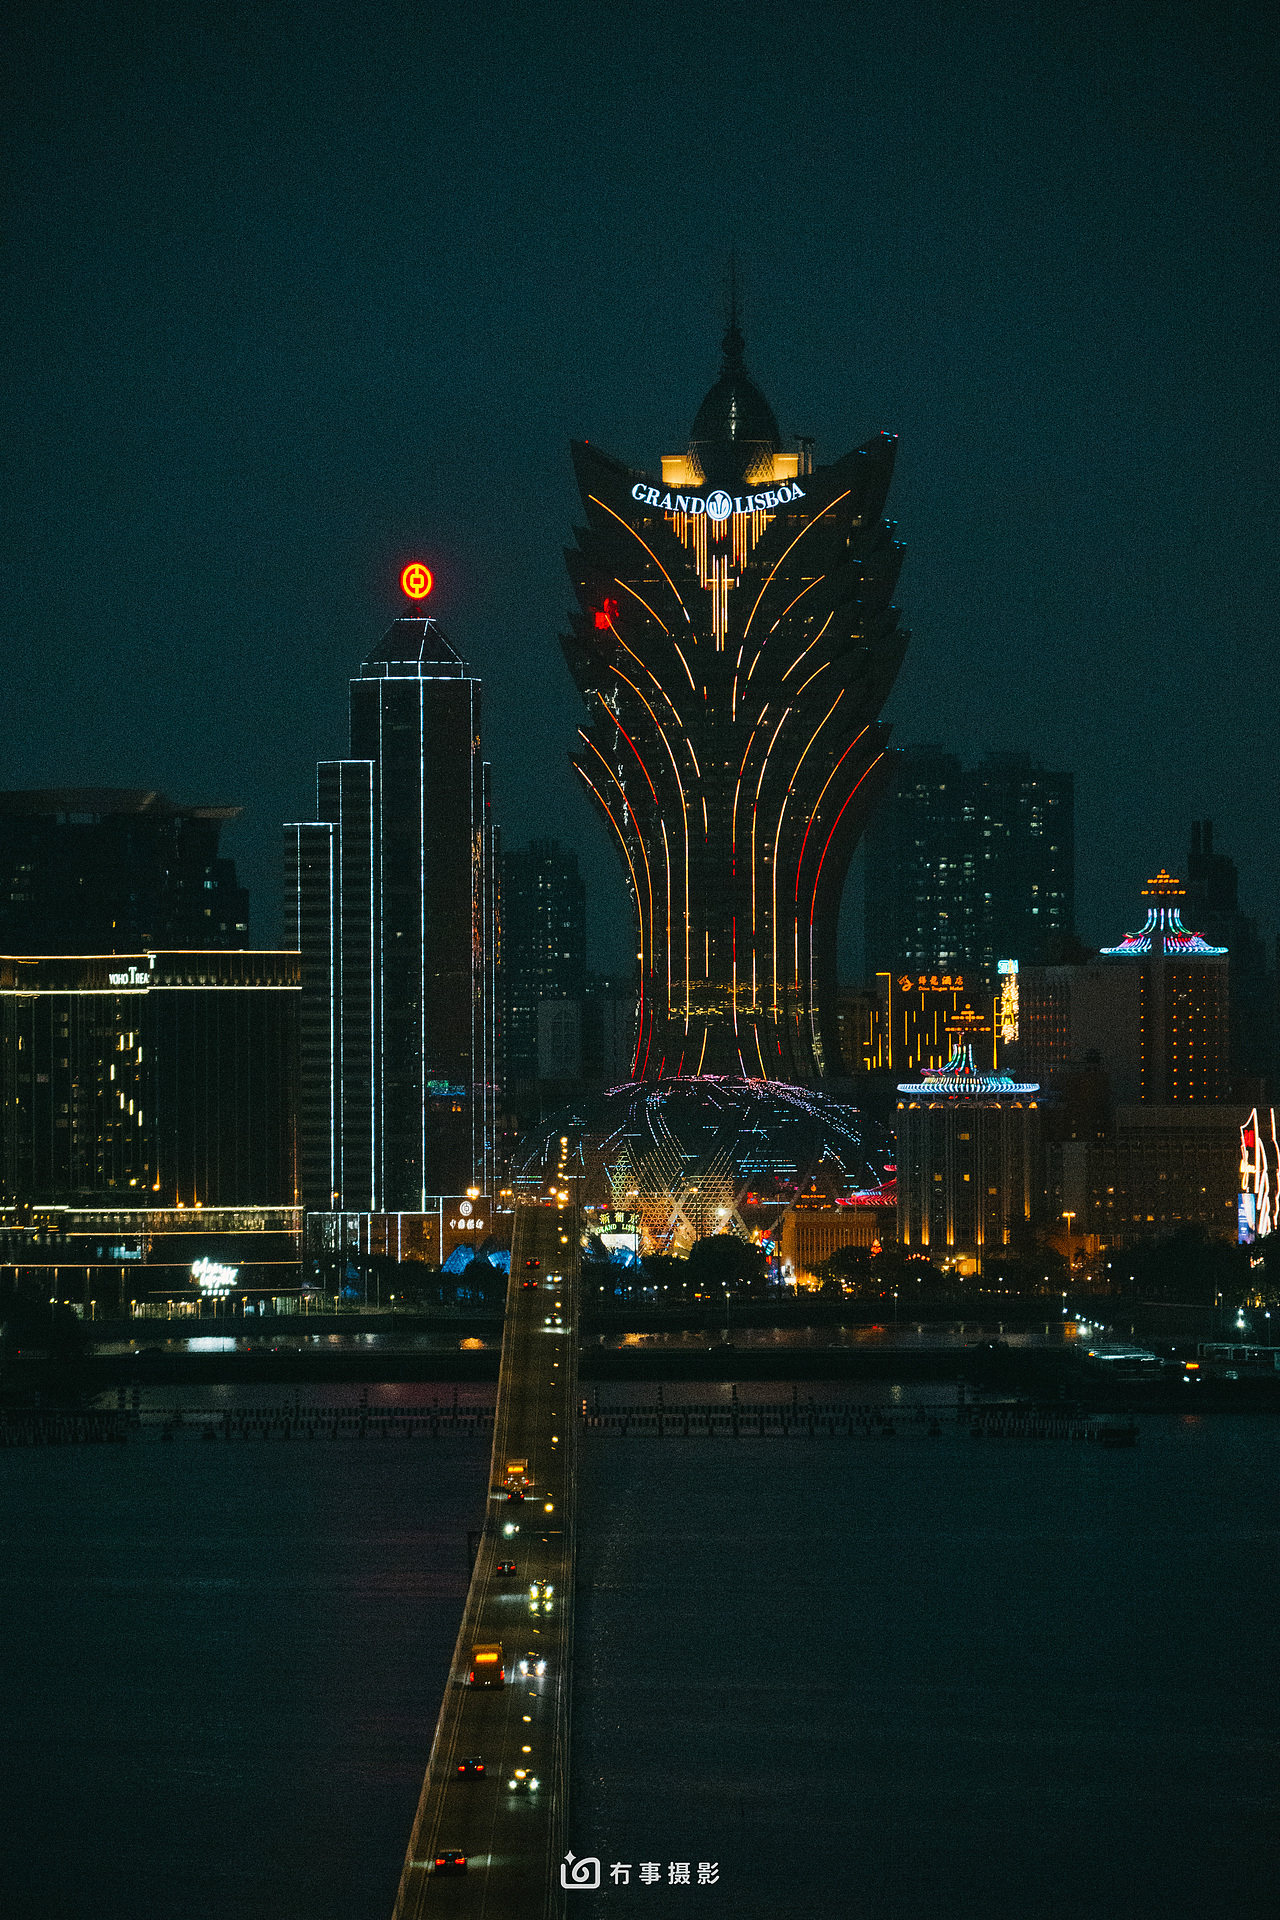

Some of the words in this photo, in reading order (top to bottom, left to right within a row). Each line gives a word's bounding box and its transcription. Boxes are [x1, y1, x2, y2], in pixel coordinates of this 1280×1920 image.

[631, 483, 706, 515] GRAND
[733, 482, 806, 514] LISBOA
[109, 973, 129, 984] YOHO
